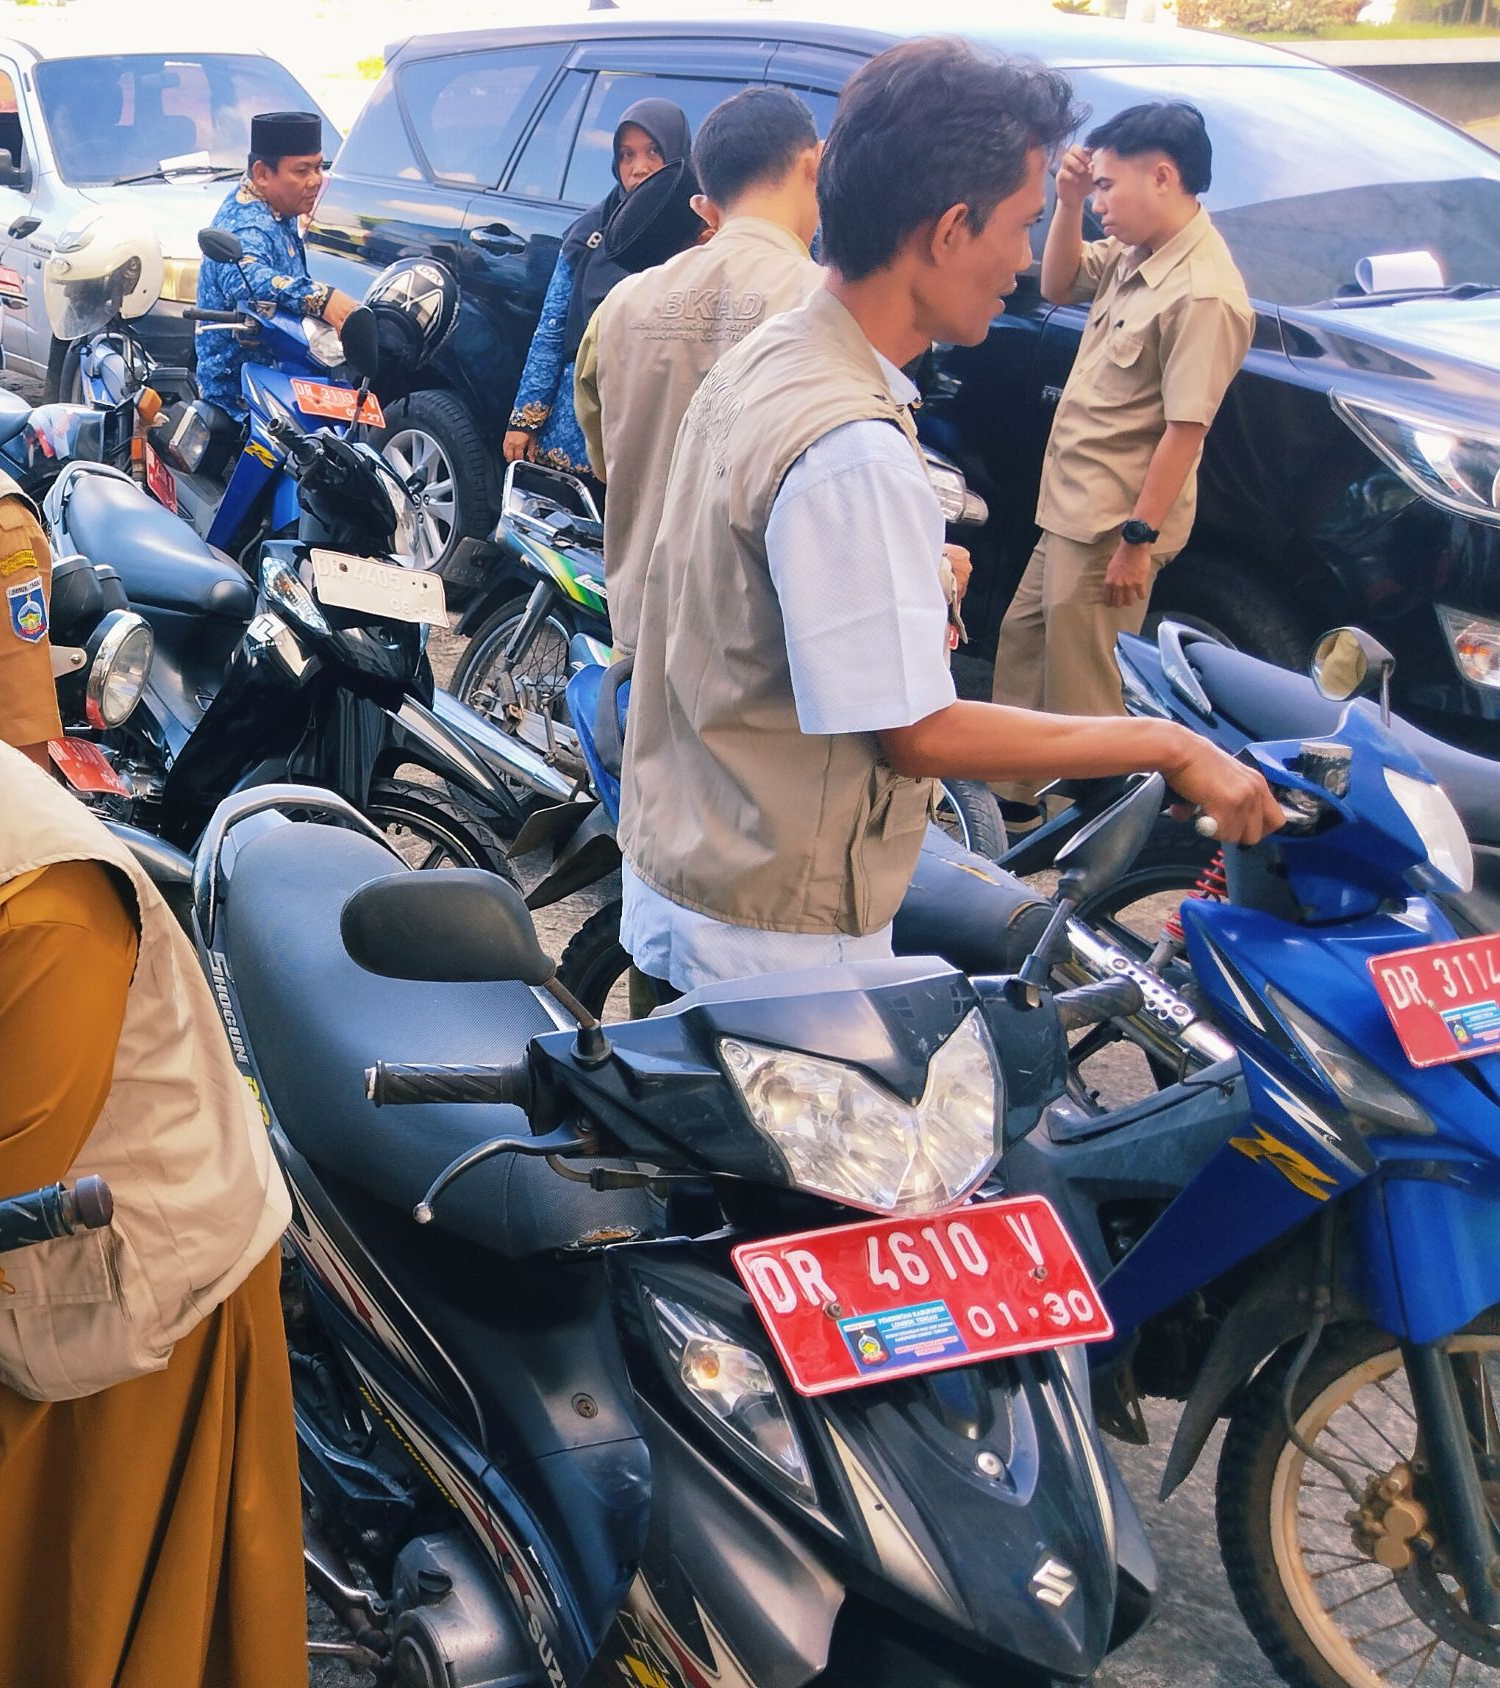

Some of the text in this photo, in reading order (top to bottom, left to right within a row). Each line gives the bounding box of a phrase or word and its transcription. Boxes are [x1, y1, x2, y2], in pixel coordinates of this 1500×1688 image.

[659, 286, 767, 321] BKAD
[295, 382, 314, 397] DR
[207, 950, 251, 1066] SHOGUN
[1381, 965, 1426, 1010] DR
[749, 1249, 839, 1315] DR
[866, 1221, 990, 1291] 4610
[1004, 1212, 1045, 1267] V
